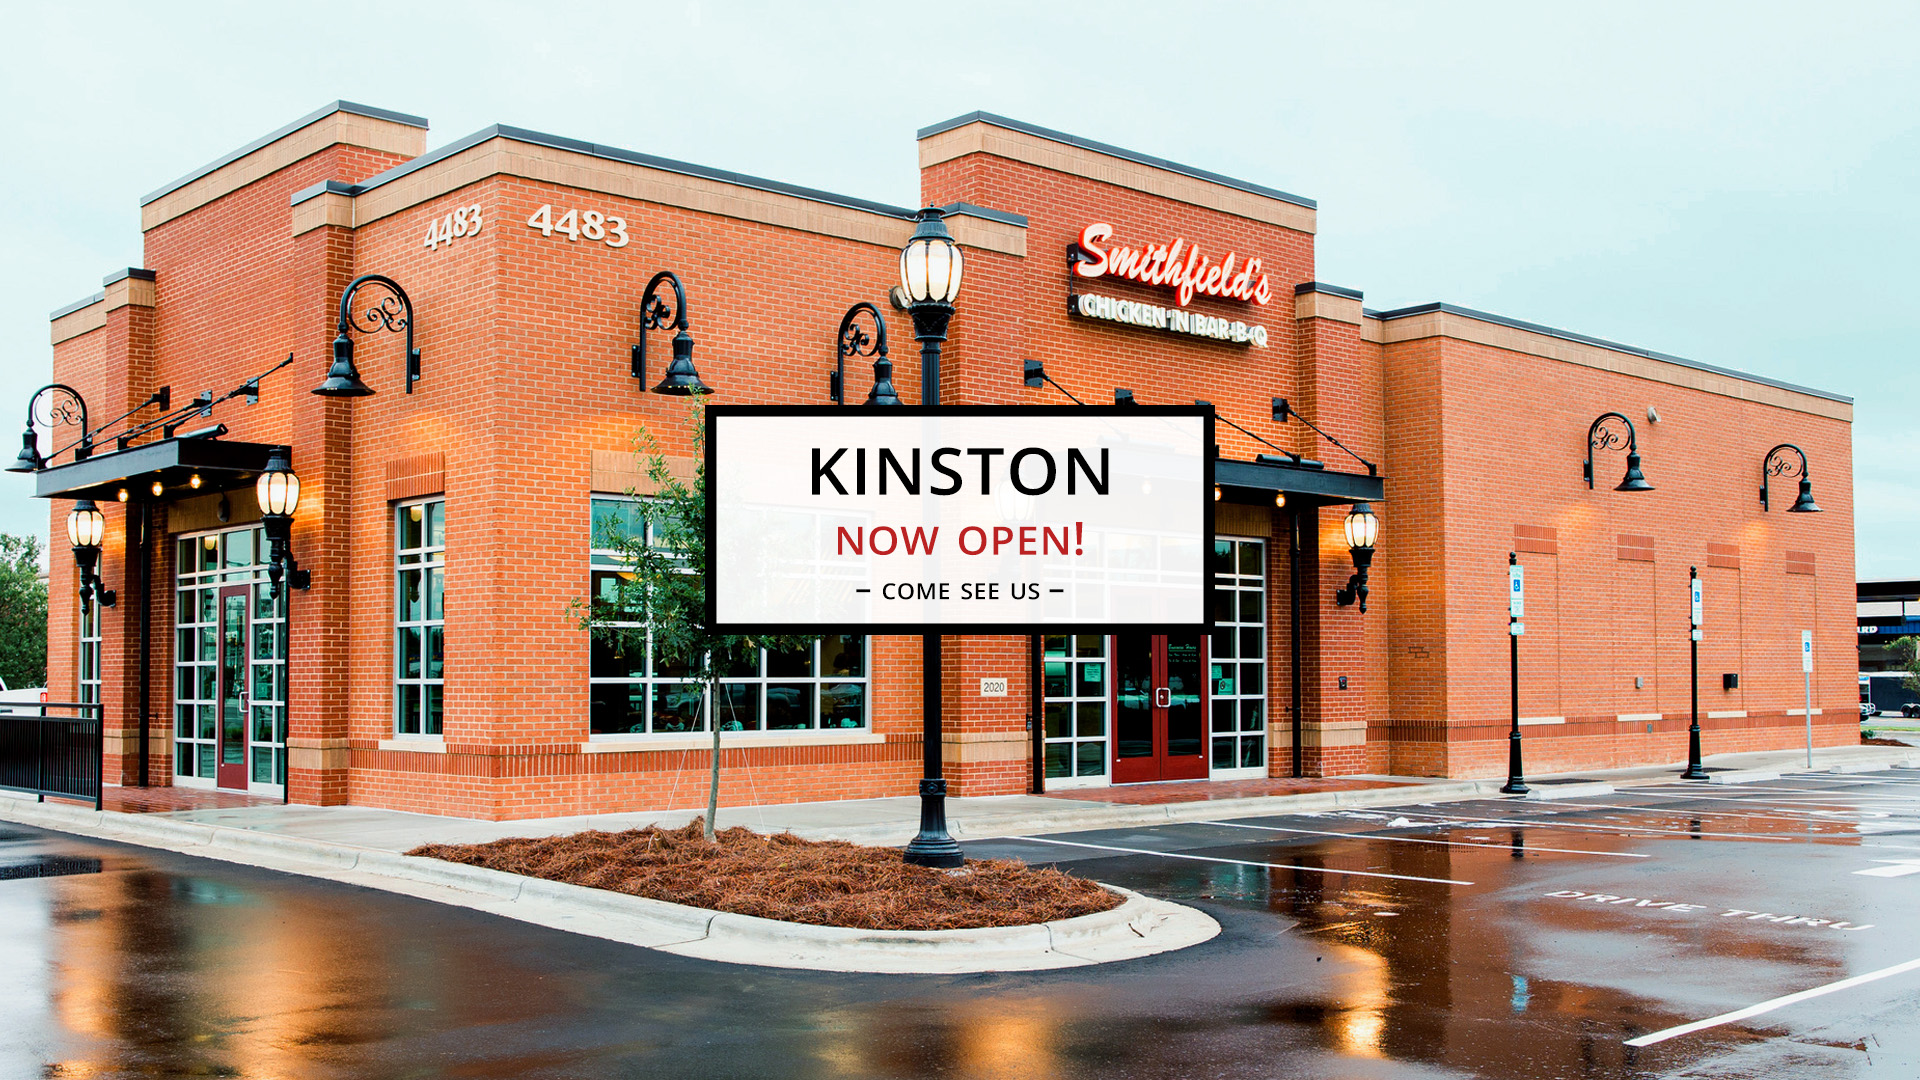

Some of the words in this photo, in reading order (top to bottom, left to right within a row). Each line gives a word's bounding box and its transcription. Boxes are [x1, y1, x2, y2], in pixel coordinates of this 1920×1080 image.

[424, 203, 483, 251] 4483
[527, 204, 630, 248] 4483
[1073, 222, 1272, 307] Smithfield's
[1078, 293, 1166, 328] CHICKEN
[983, 681, 1005, 693] 2020
[1544, 890, 1707, 913] DRIVE
[1720, 908, 1876, 931] THRU
